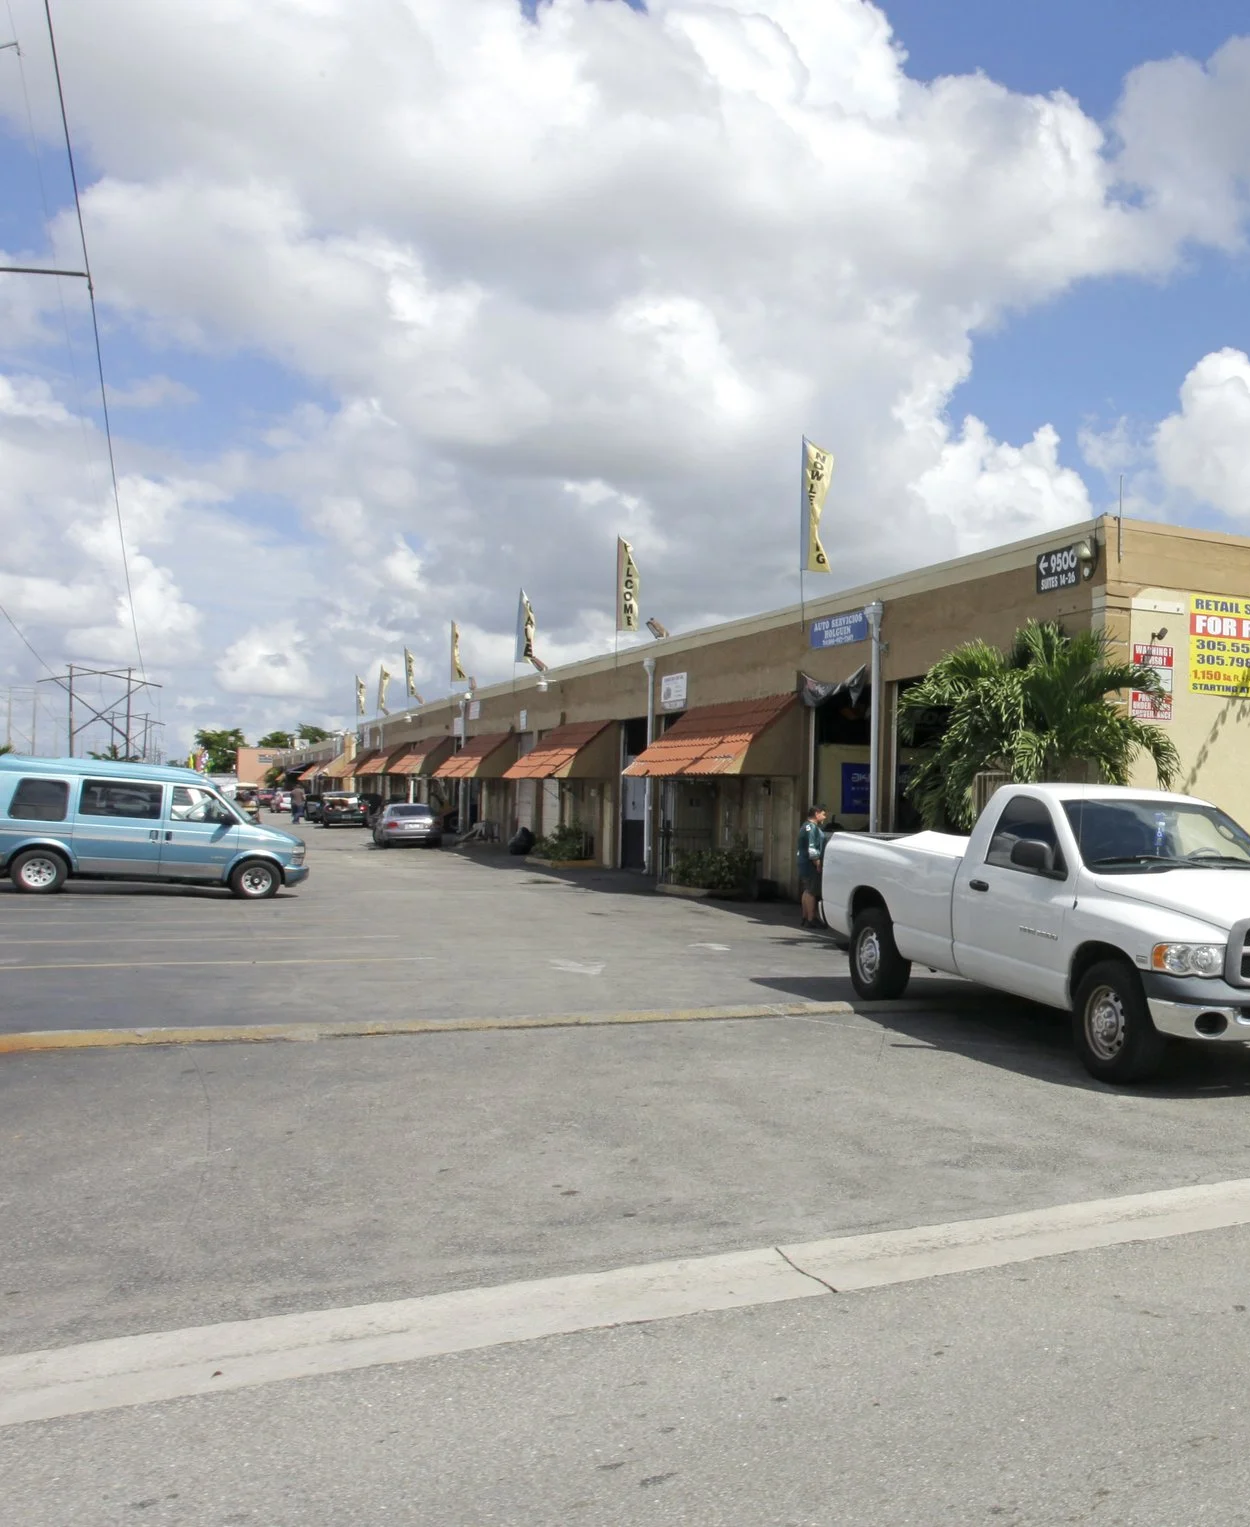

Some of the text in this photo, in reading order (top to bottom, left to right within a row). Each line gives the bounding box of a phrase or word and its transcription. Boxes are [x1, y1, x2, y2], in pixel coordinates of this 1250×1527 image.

[1050, 548, 1077, 573] 9500
[1041, 575, 1058, 591] SUITES
[1195, 598, 1240, 614] RETAIL
[813, 612, 863, 633] AUTO SERVICIOS
[1195, 614, 1237, 637] FOR
[1192, 669, 1221, 681] 1,150
[1192, 683, 1250, 694] STARTING AT
